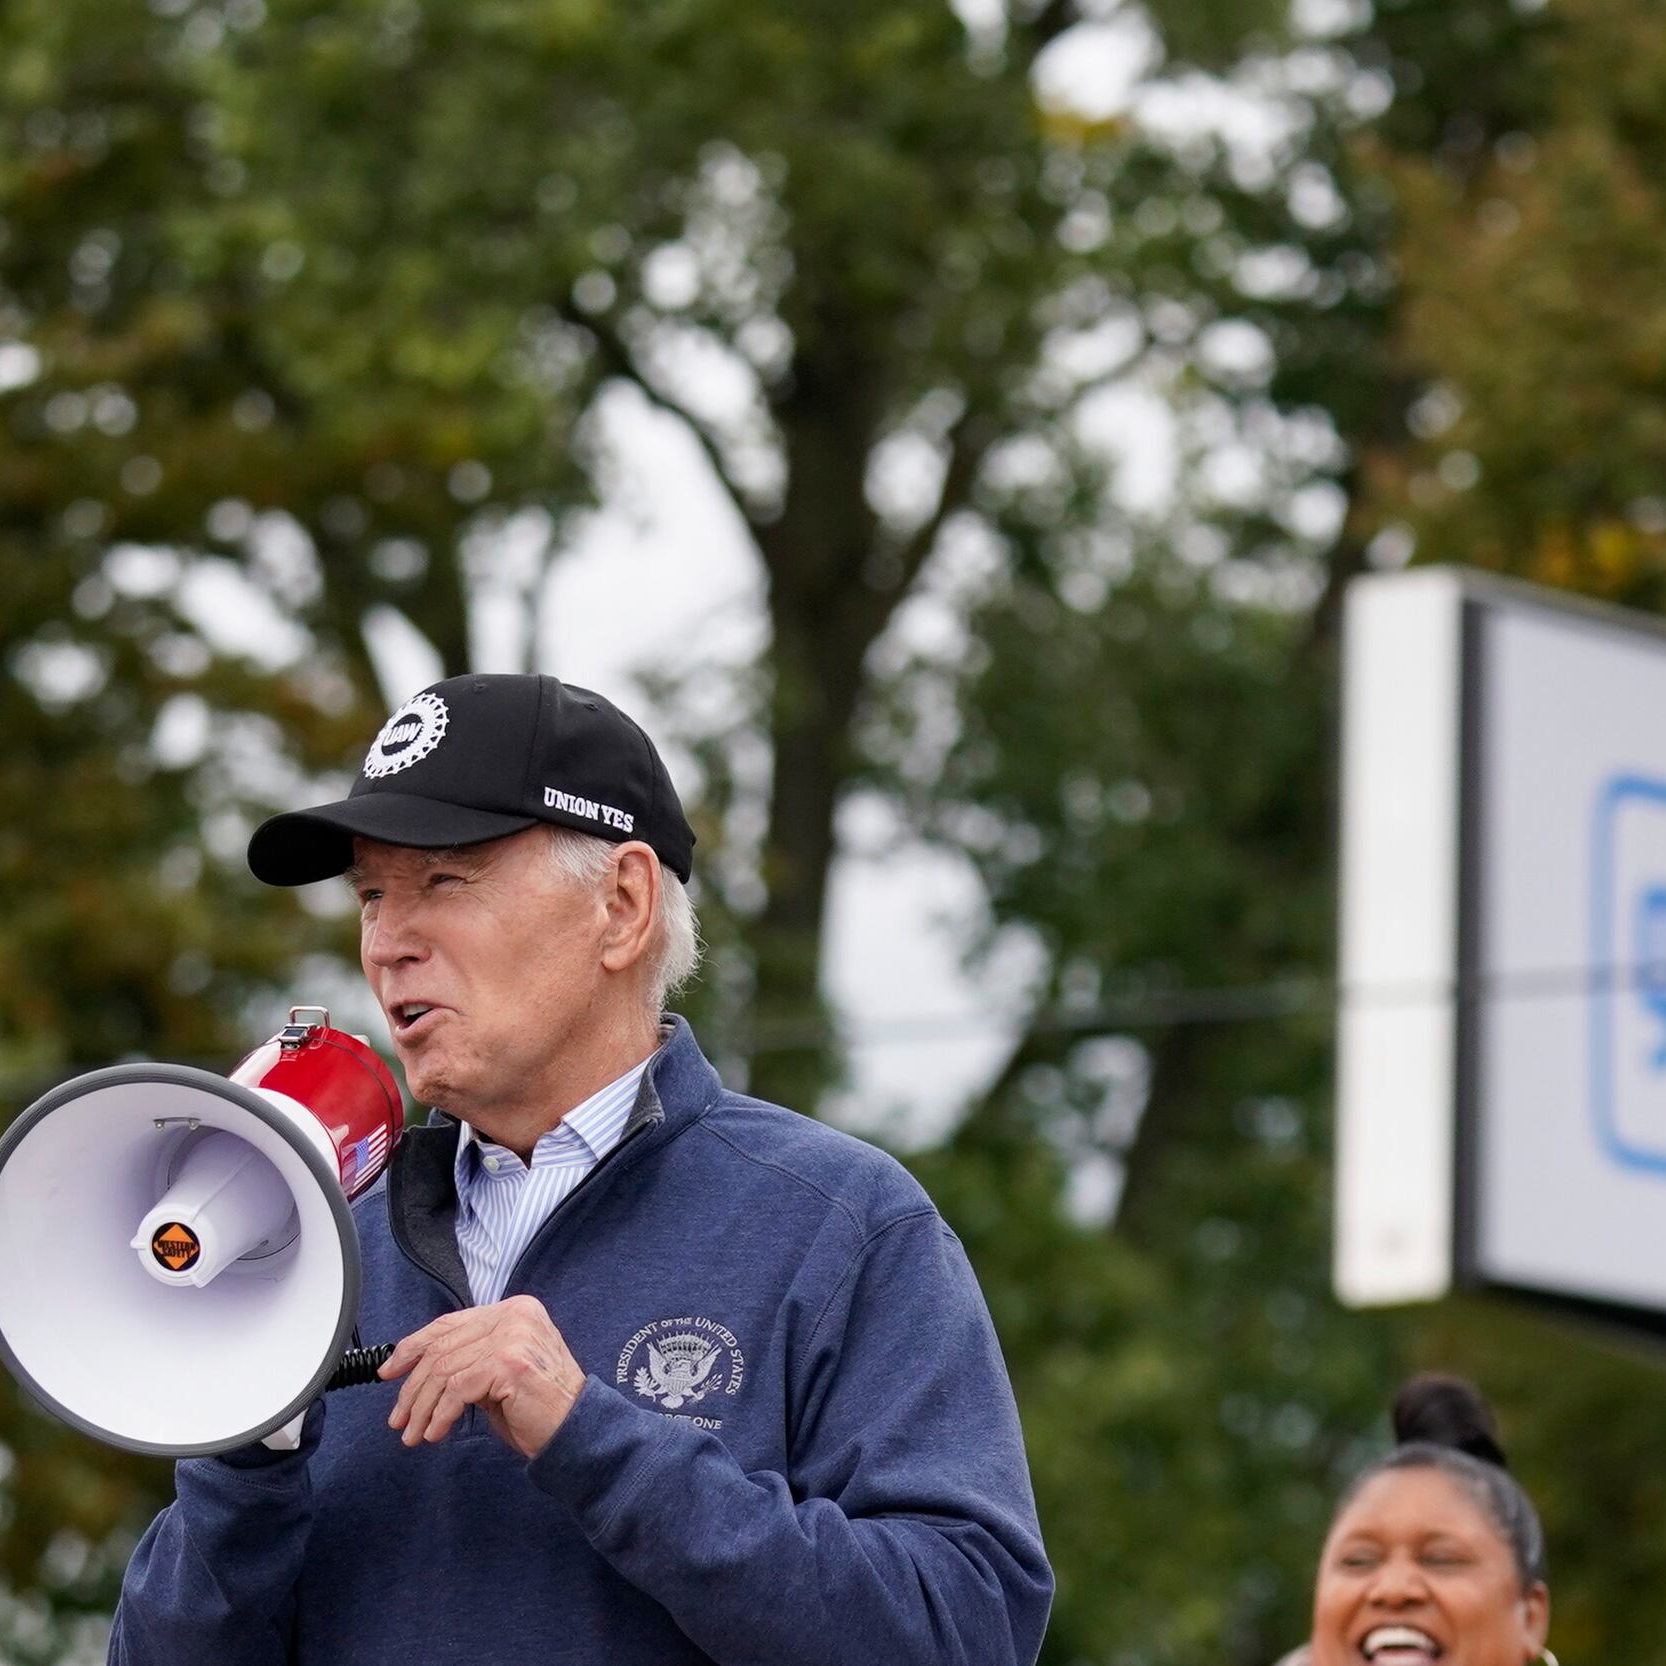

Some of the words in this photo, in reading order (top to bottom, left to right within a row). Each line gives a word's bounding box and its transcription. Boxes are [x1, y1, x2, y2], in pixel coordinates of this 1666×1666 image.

[383, 723, 423, 746] UAW
[544, 786, 600, 821] UNION
[600, 804, 635, 834] YES
[158, 1240, 196, 1251] WESTERN
[161, 1249, 190, 1259] SAFETY
[616, 1322, 658, 1384] PRESIDENT
[695, 1317, 738, 1347] UNITED
[725, 1349, 744, 1396] STATES
[693, 1417, 723, 1430] ONE
